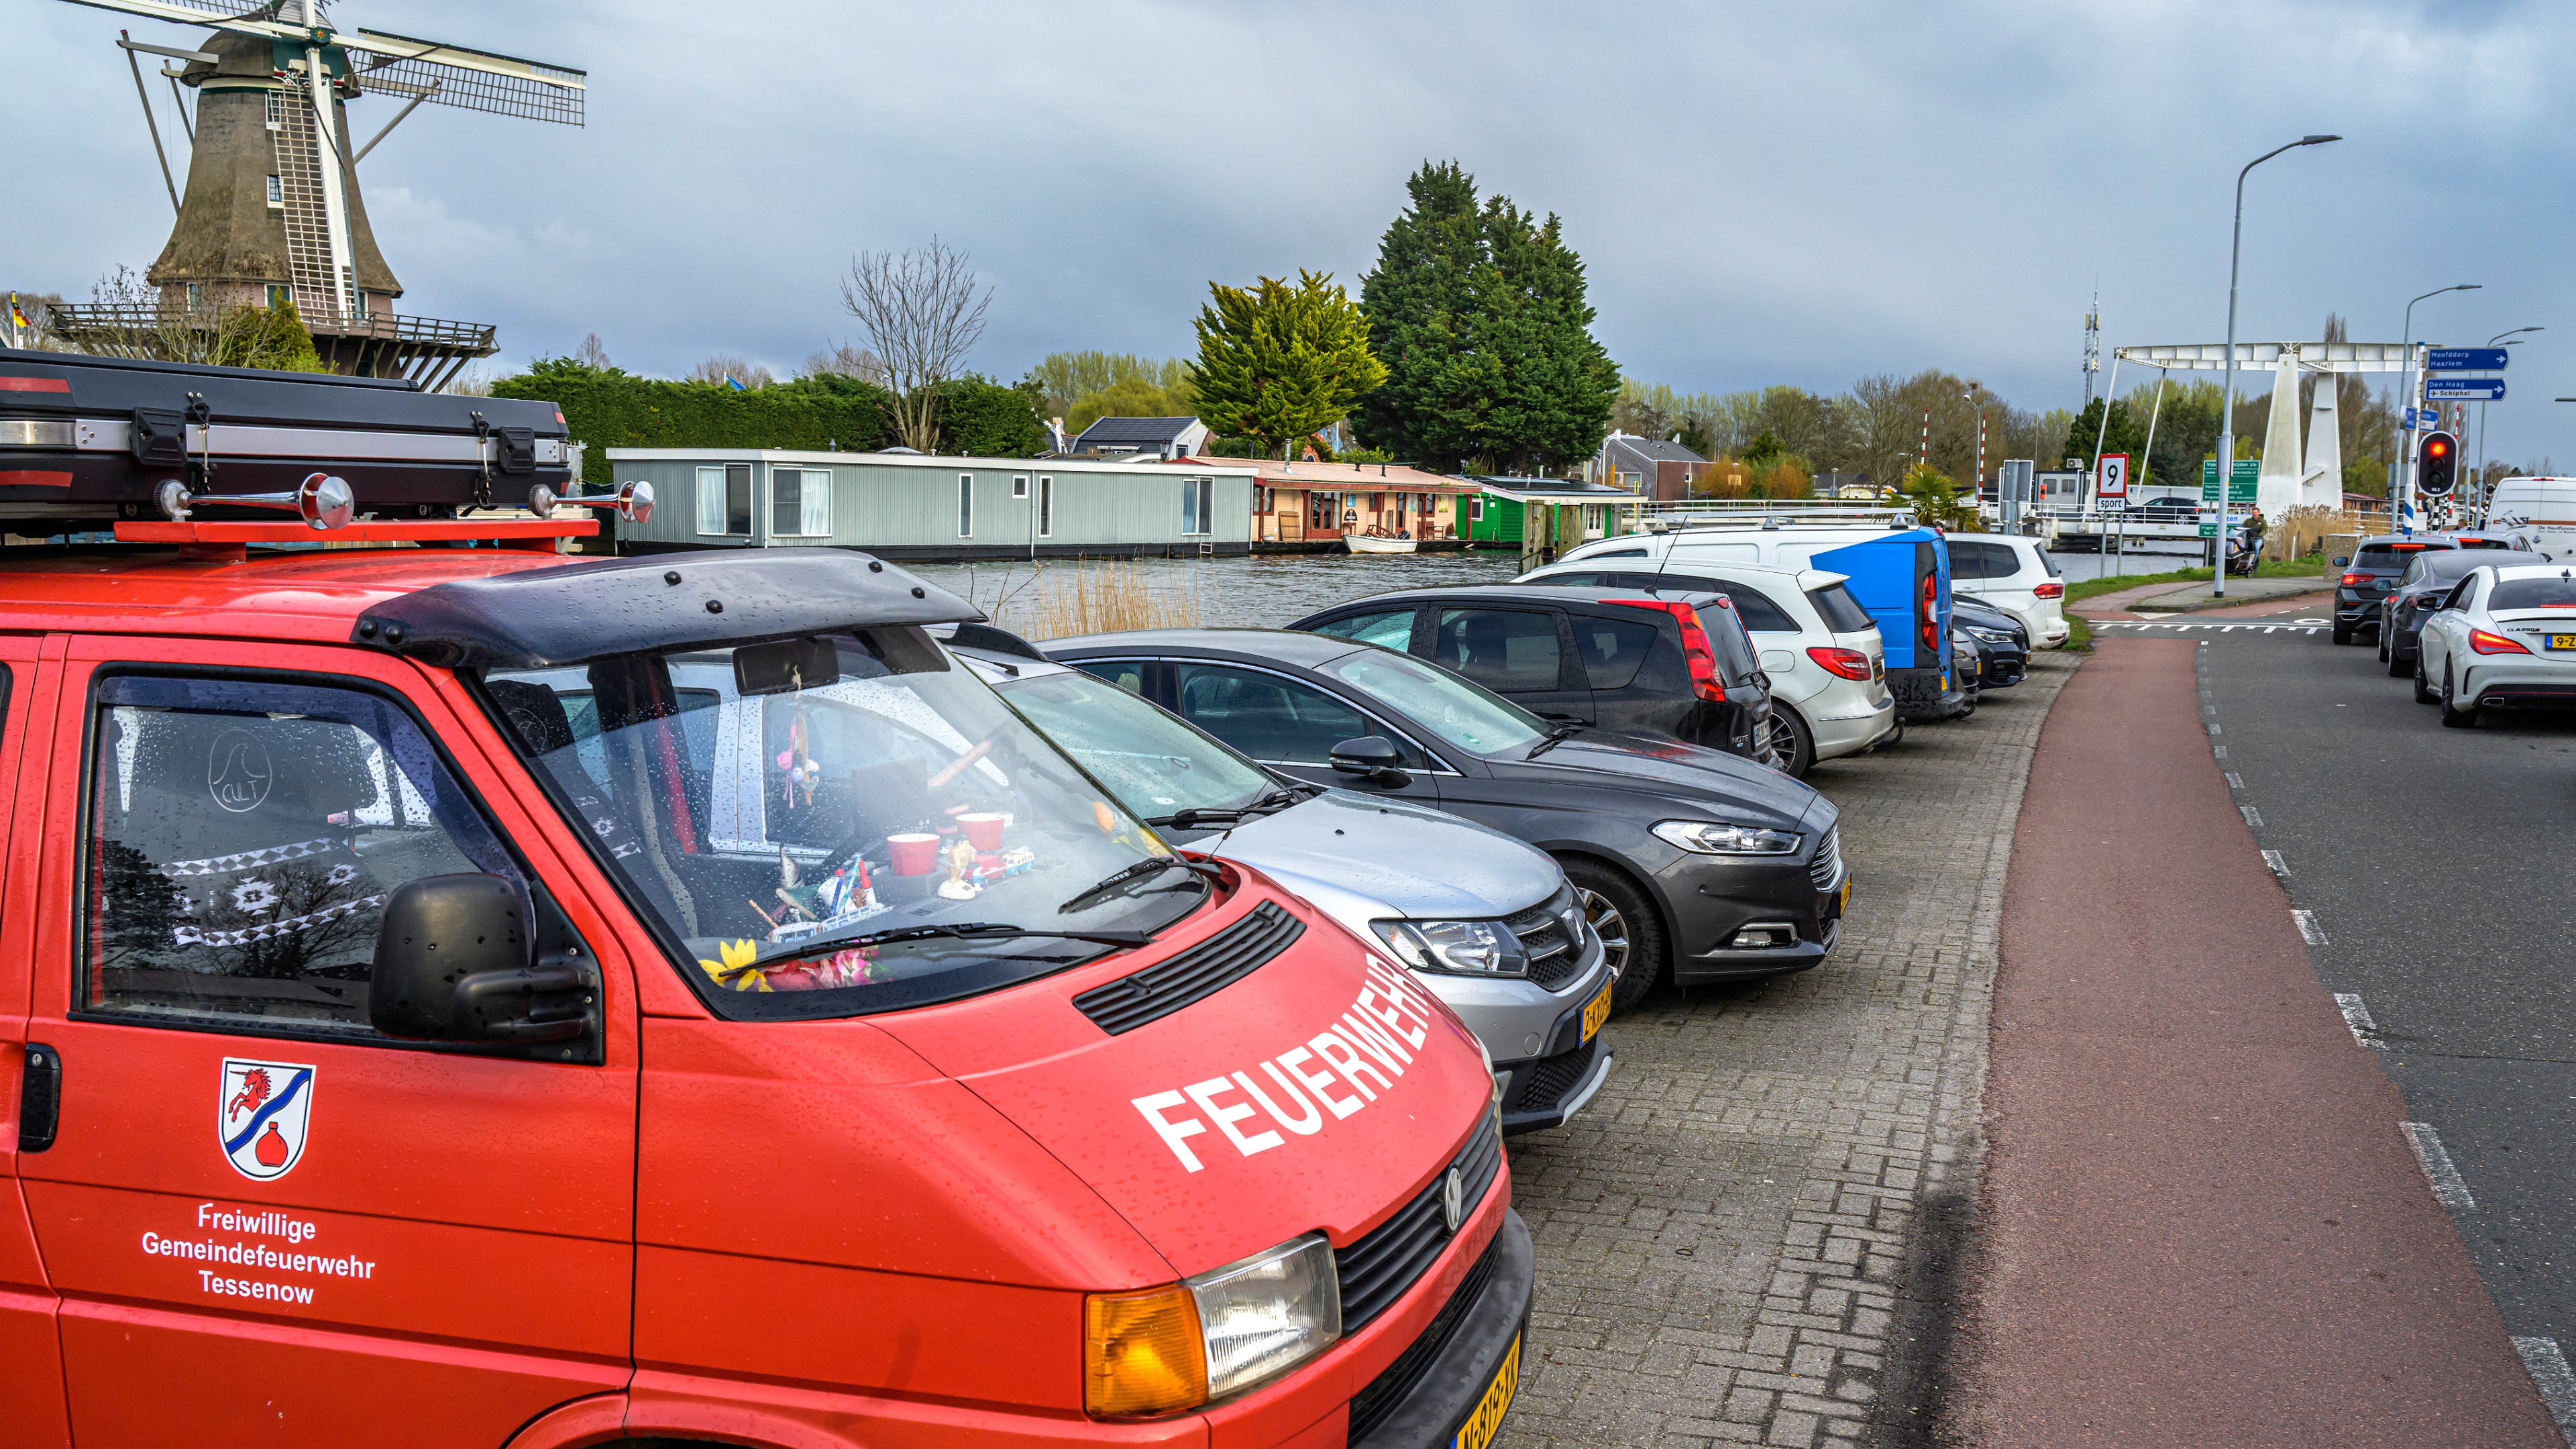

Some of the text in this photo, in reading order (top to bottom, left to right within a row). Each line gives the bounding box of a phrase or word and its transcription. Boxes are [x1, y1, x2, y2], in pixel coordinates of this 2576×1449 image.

[2108, 464, 2118, 486] 9
[2100, 500, 2122, 509] sport
[222, 780, 257, 802] CULT
[1130, 952, 1430, 1174] FEUERWEHR
[198, 1203, 316, 1244] Freiwillige
[142, 1232, 376, 1279] Gemeindefeuerwehr
[198, 1270, 314, 1304] Tessenow
